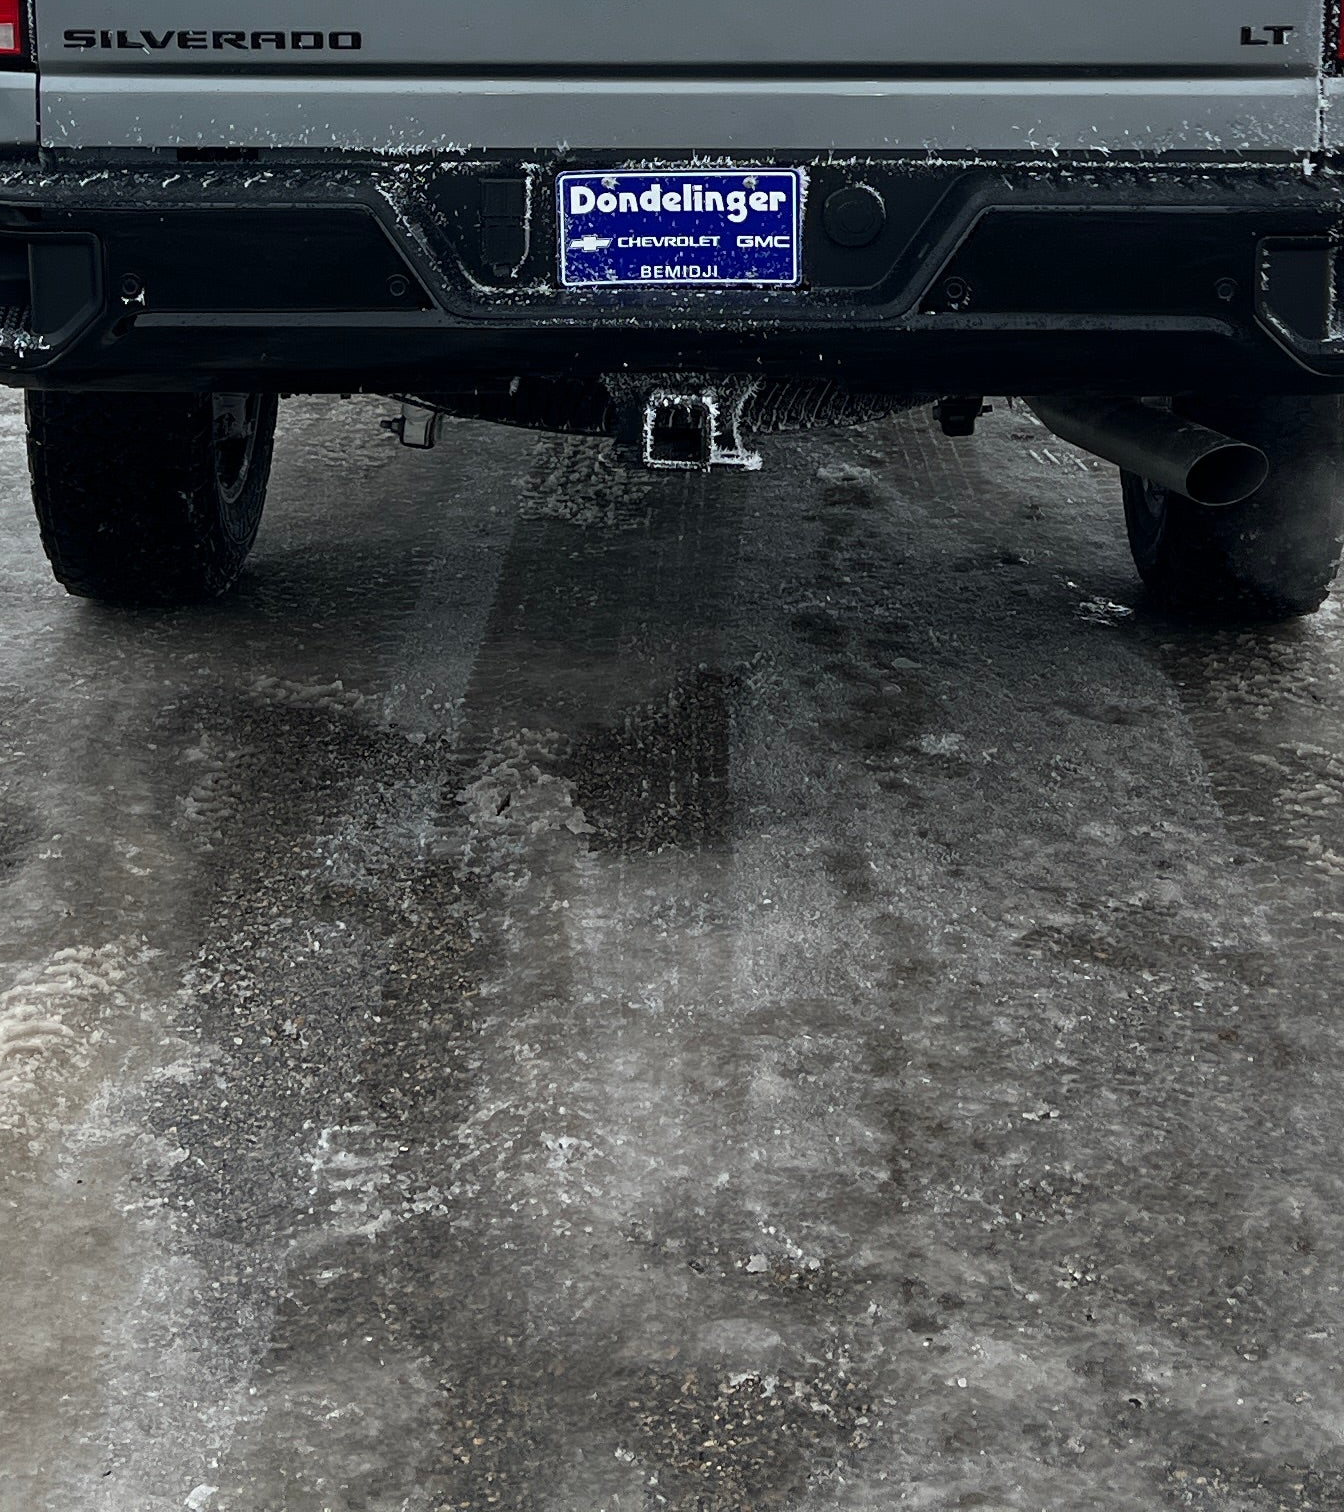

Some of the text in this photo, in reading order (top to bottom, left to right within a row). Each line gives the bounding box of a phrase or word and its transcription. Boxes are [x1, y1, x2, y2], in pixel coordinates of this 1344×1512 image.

[63, 29, 362, 50] SILVERADO
[1240, 26, 1294, 45] LT
[570, 184, 786, 223] Dondelinger
[617, 235, 791, 248] CHEVROLET GMC
[640, 265, 719, 279] BEMIDJI
